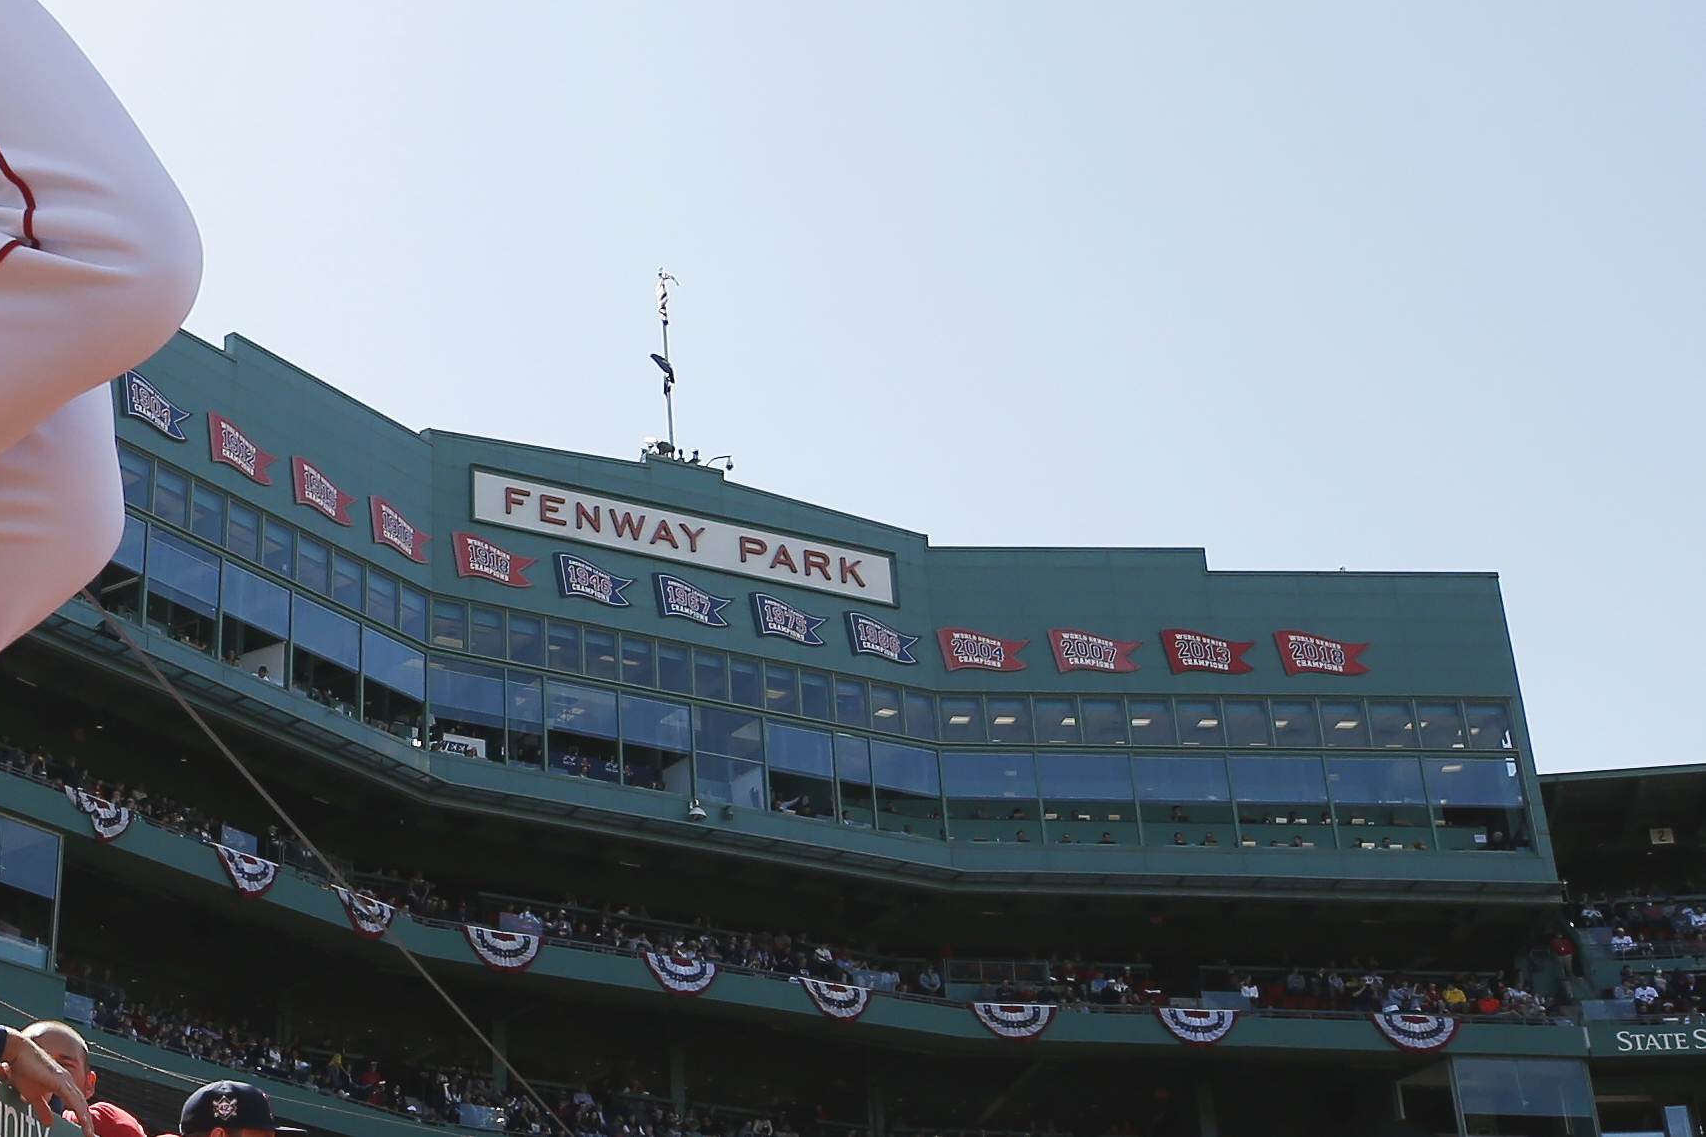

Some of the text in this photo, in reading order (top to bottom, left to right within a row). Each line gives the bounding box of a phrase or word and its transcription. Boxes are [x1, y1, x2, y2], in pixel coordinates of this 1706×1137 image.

[505, 486, 866, 589] FENWAY PARK
[468, 545, 510, 575] 1918
[568, 565, 612, 597] 1946
[667, 585, 710, 615] 1967
[764, 605, 807, 635] 1975
[951, 639, 1004, 662] 2004
[958, 655, 1002, 667] CHAMPIONS
[1060, 640, 1117, 663] 2007
[1175, 640, 1230, 665] 2013
[1288, 642, 1345, 665] 2018
[1068, 657, 1114, 669] CHAMPIONS
[1182, 658, 1228, 670] CHAMPIONS
[1296, 659, 1344, 672] CHAMPIONS
[1657, 829, 1667, 842] 2
[1616, 1030, 1689, 1051] STATE
